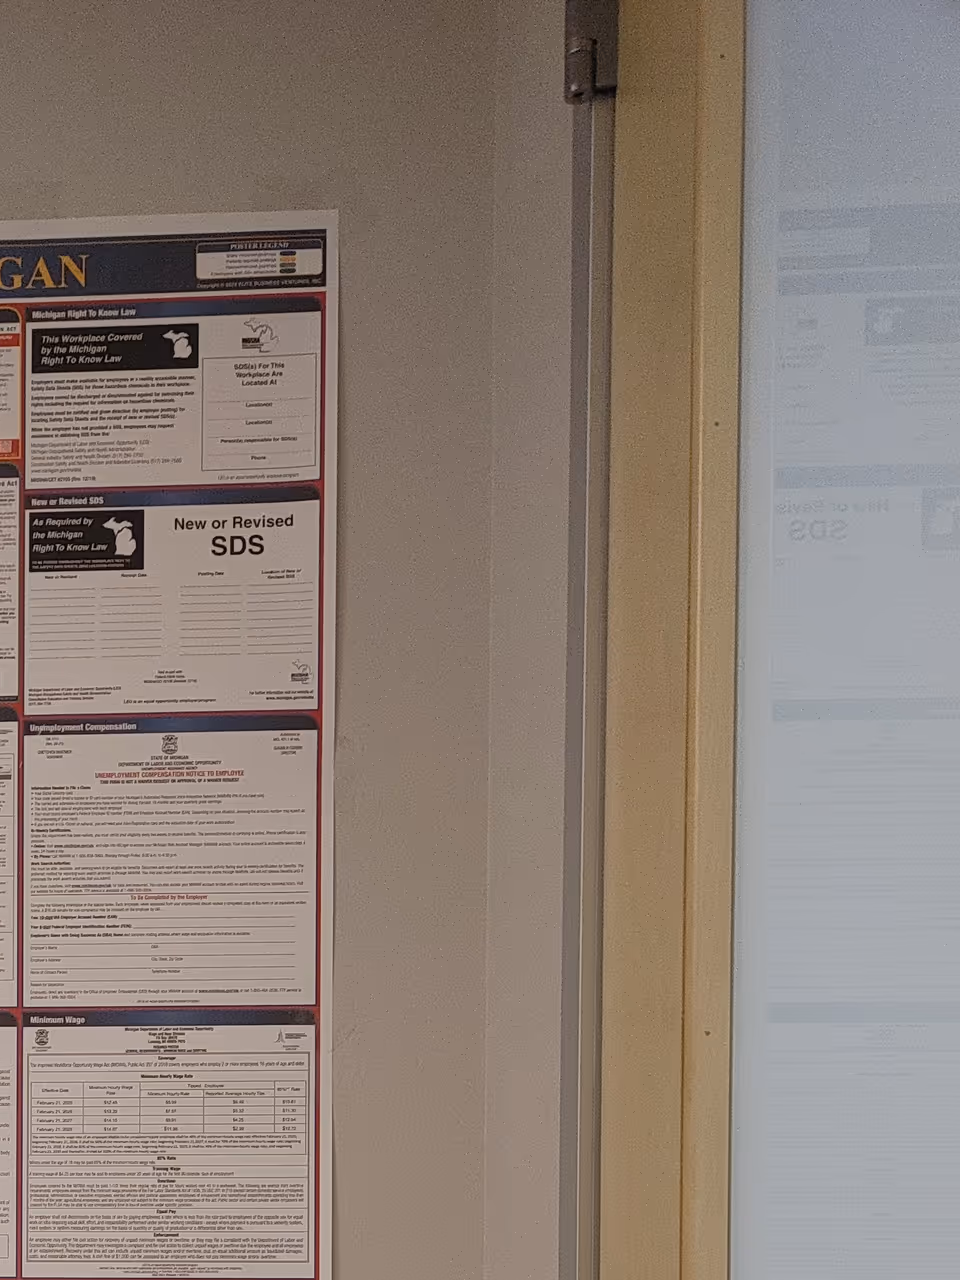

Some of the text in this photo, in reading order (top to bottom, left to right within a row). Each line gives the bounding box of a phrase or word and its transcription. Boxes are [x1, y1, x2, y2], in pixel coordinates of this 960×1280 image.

[42, 333, 143, 344] This Workplace Covered
[41, 347, 52, 356] by
[69, 345, 107, 355] Michigan
[41, 356, 64, 367] Right
[66, 356, 77, 364] To
[78, 356, 103, 364] Know
[58, 497, 88, 505] Revised
[89, 496, 104, 505] SDS
[45, 518, 82, 527] Required
[83, 518, 93, 527] by
[174, 516, 294, 530] New or Revised
[47, 531, 83, 540] Michigan
[32, 544, 54, 554] Right
[212, 534, 264, 556] SDS
[30, 723, 137, 733] Unemployment Compensation
[65, 1016, 85, 1025] Wage
